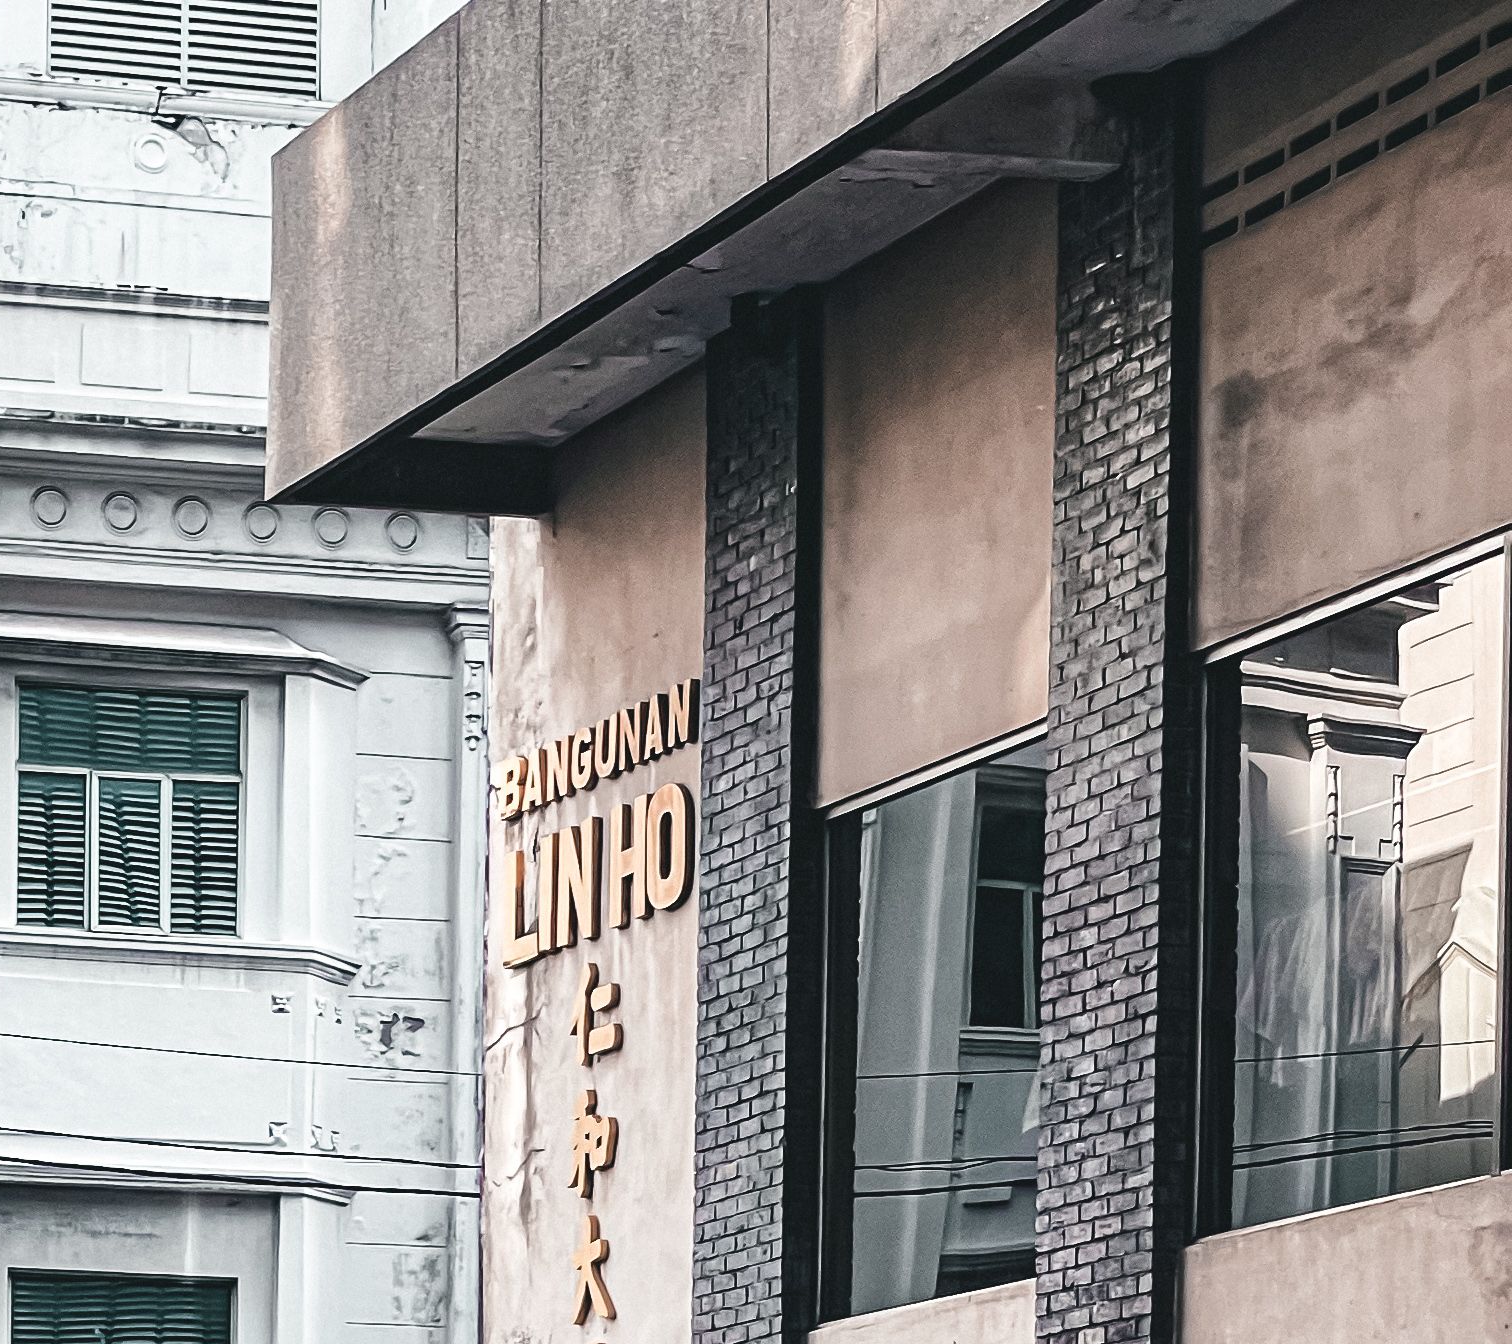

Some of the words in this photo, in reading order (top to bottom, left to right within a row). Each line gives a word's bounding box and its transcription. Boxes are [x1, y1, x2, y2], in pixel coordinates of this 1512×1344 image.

[496, 678, 700, 821] BANGUNAN
[502, 816, 603, 969] LIN
[609, 783, 695, 929] HO
